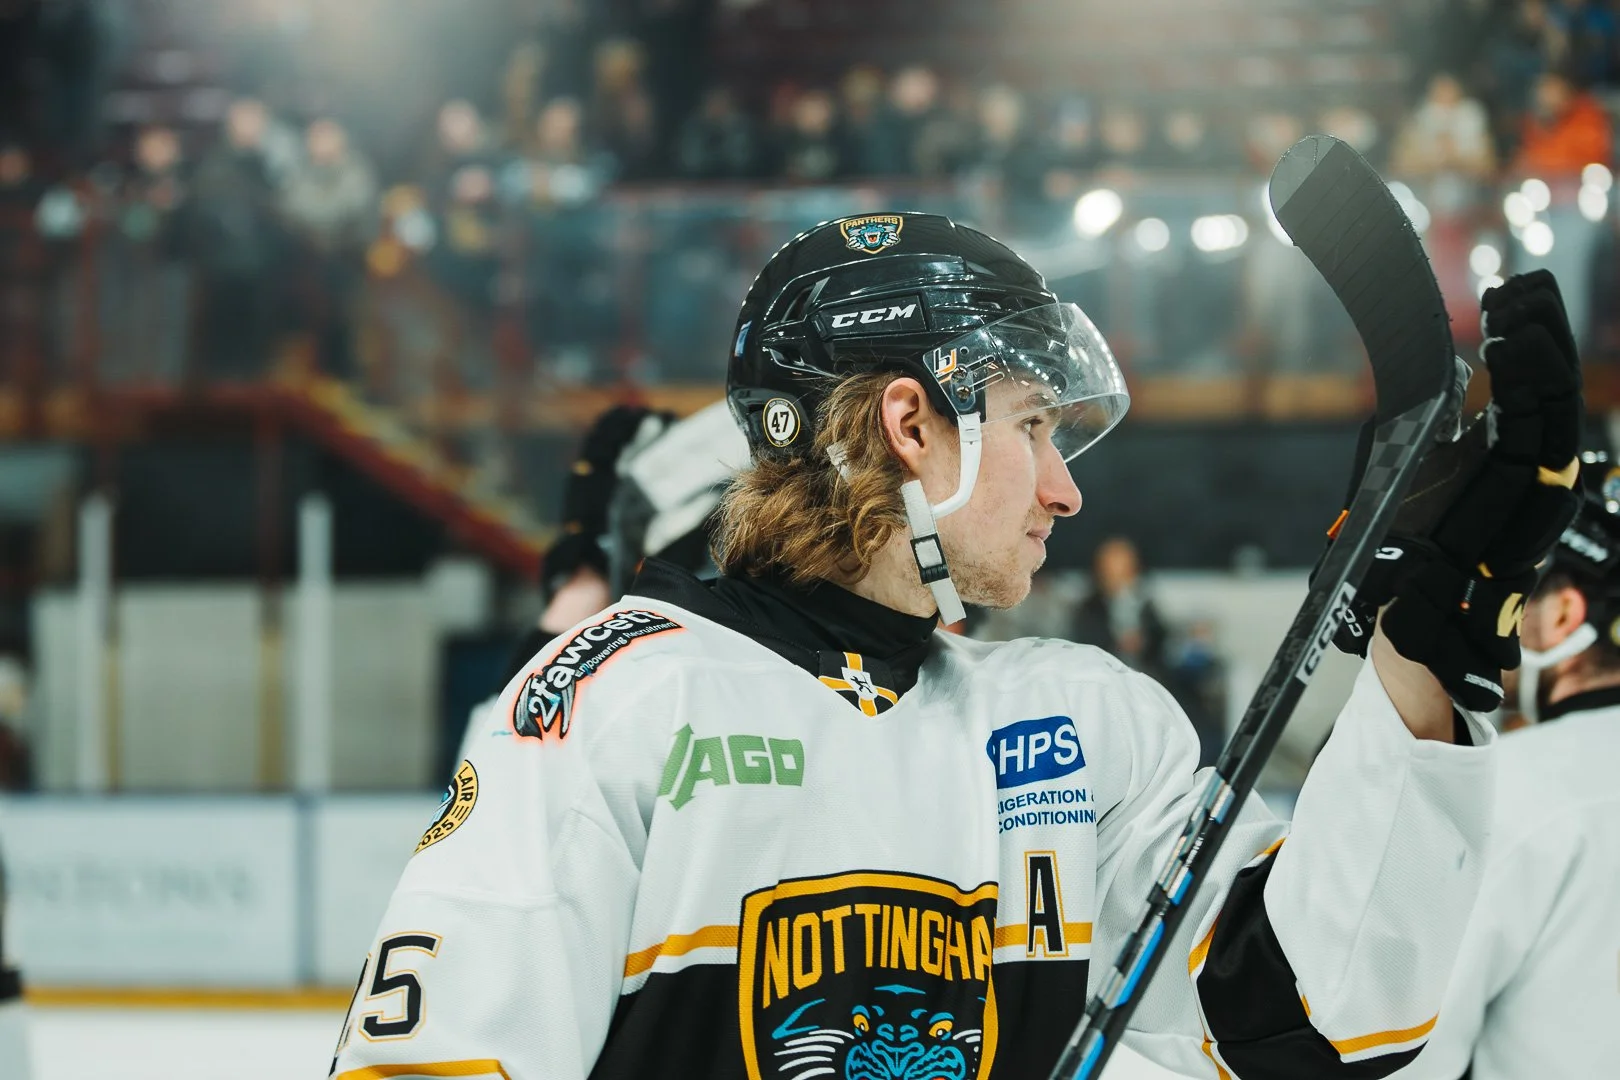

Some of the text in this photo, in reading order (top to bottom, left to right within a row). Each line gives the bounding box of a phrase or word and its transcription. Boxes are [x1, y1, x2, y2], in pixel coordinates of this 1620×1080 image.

[845, 216, 899, 230] PANTHERS
[831, 303, 917, 329] CCM
[771, 411, 790, 434] 47
[622, 621, 678, 639] Recruitment
[458, 766, 475, 802] LAIR
[415, 818, 455, 853] 025
[998, 809, 1097, 834] ONDITIONIN
[1025, 850, 1069, 957] A
[762, 903, 997, 1009] NOTTINGHA
[338, 931, 443, 1052] 5
